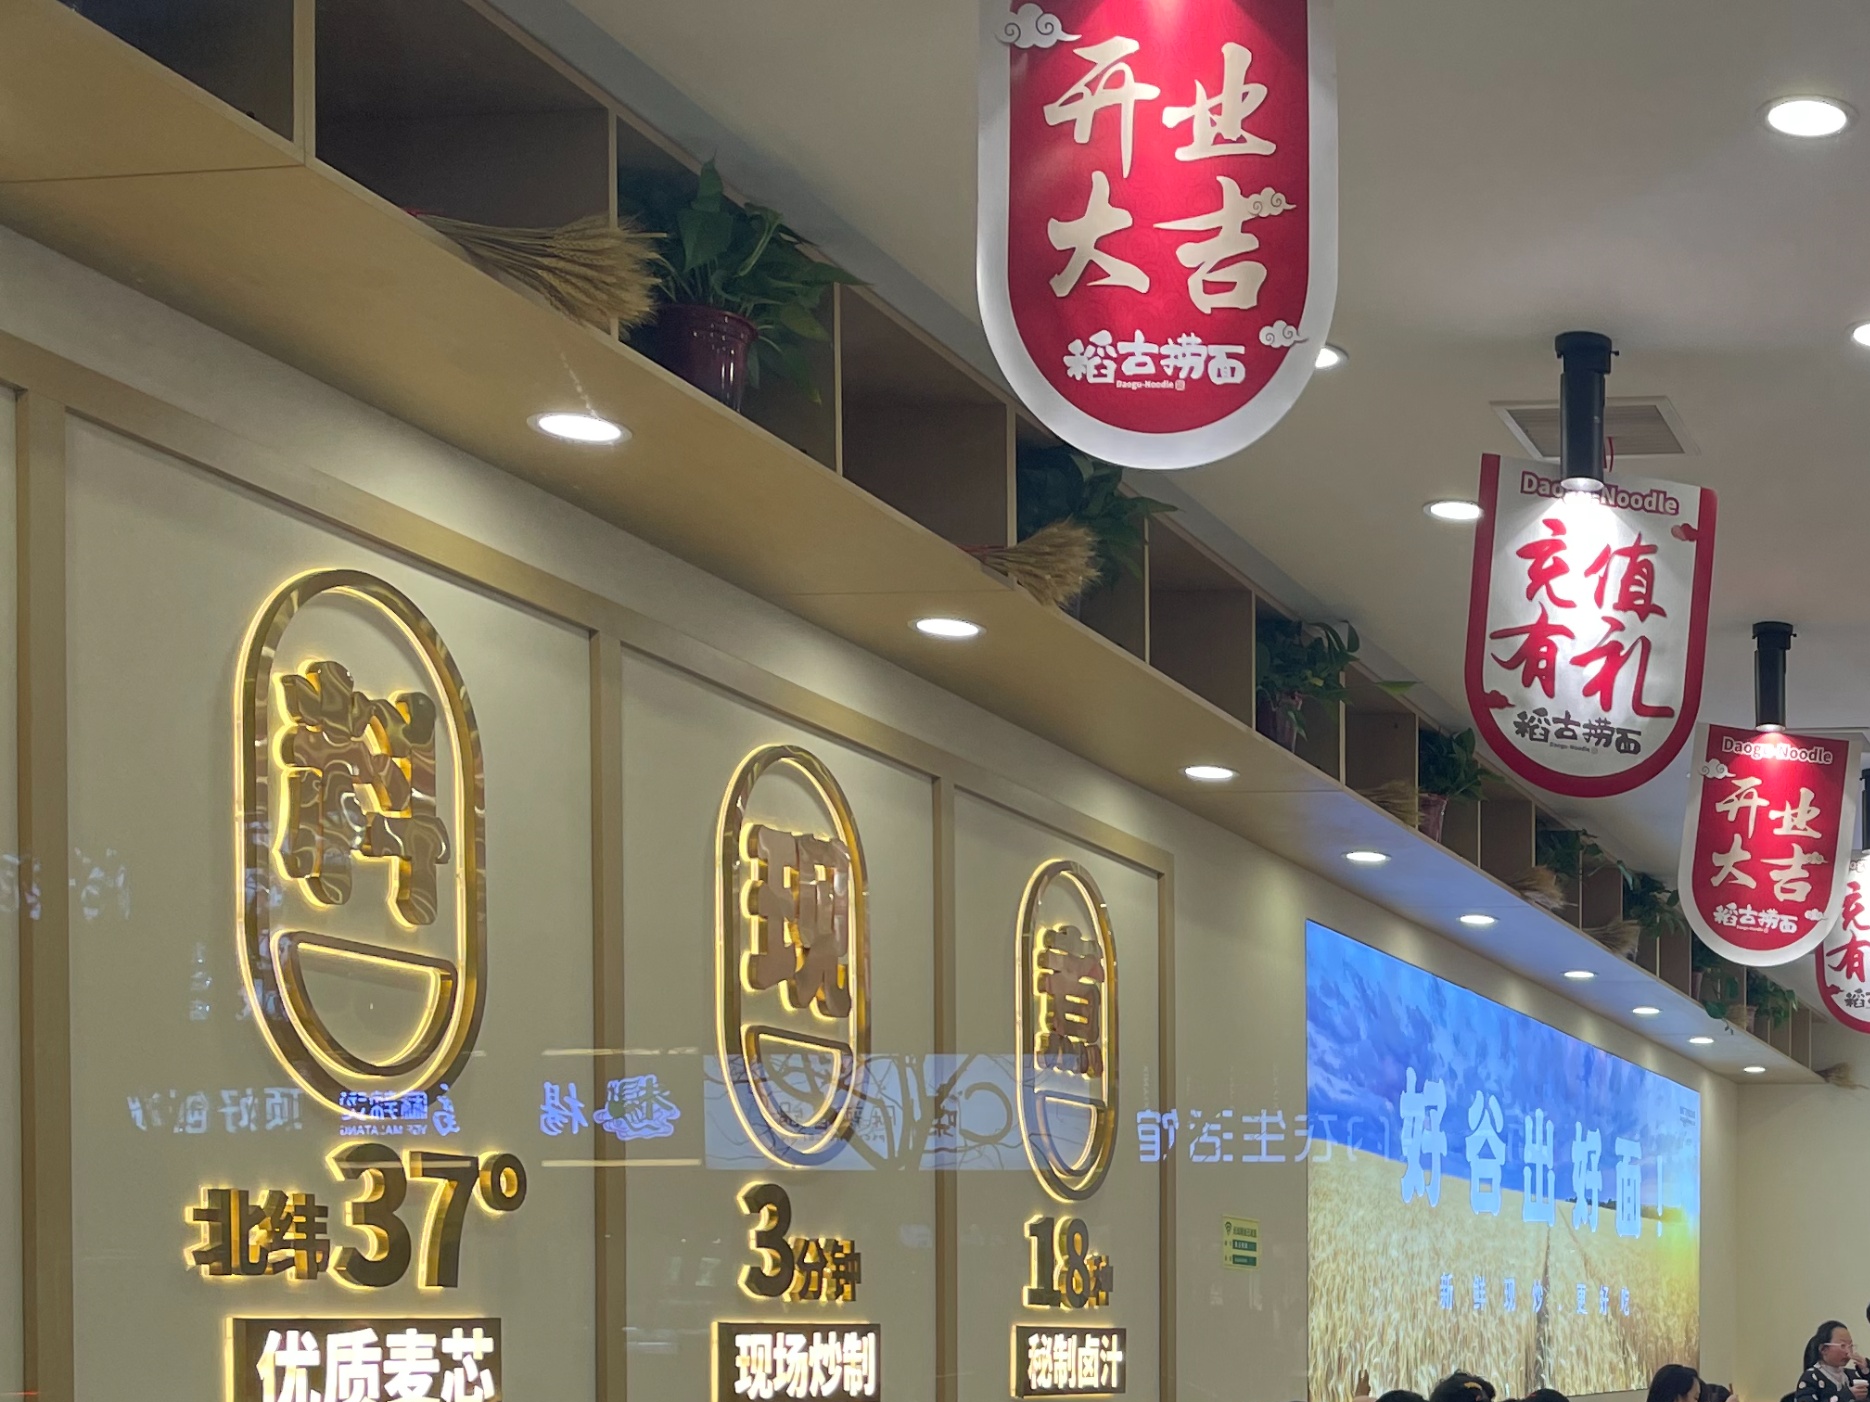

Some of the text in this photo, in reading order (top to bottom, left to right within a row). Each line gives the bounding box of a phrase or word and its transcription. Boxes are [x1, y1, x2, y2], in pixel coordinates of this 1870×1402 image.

[1043, 36, 1276, 178] 开业
[1047, 171, 1270, 314] 大吉
[1063, 330, 1246, 384] 稻古捞面
[1516, 518, 1667, 622] 充值
[1489, 601, 1675, 719] 有礼
[1514, 707, 1641, 755] 稻古捞面
[1715, 776, 1823, 839] 开业
[1710, 833, 1813, 902] 大吉
[741, 822, 852, 1019] 现
[1713, 902, 1798, 934] 稻古捞面
[736, 1180, 862, 1303] 3分钟
[734, 1331, 877, 1401] 现场炒制
[1028, 1333, 1123, 1390] 秘制卤汁
